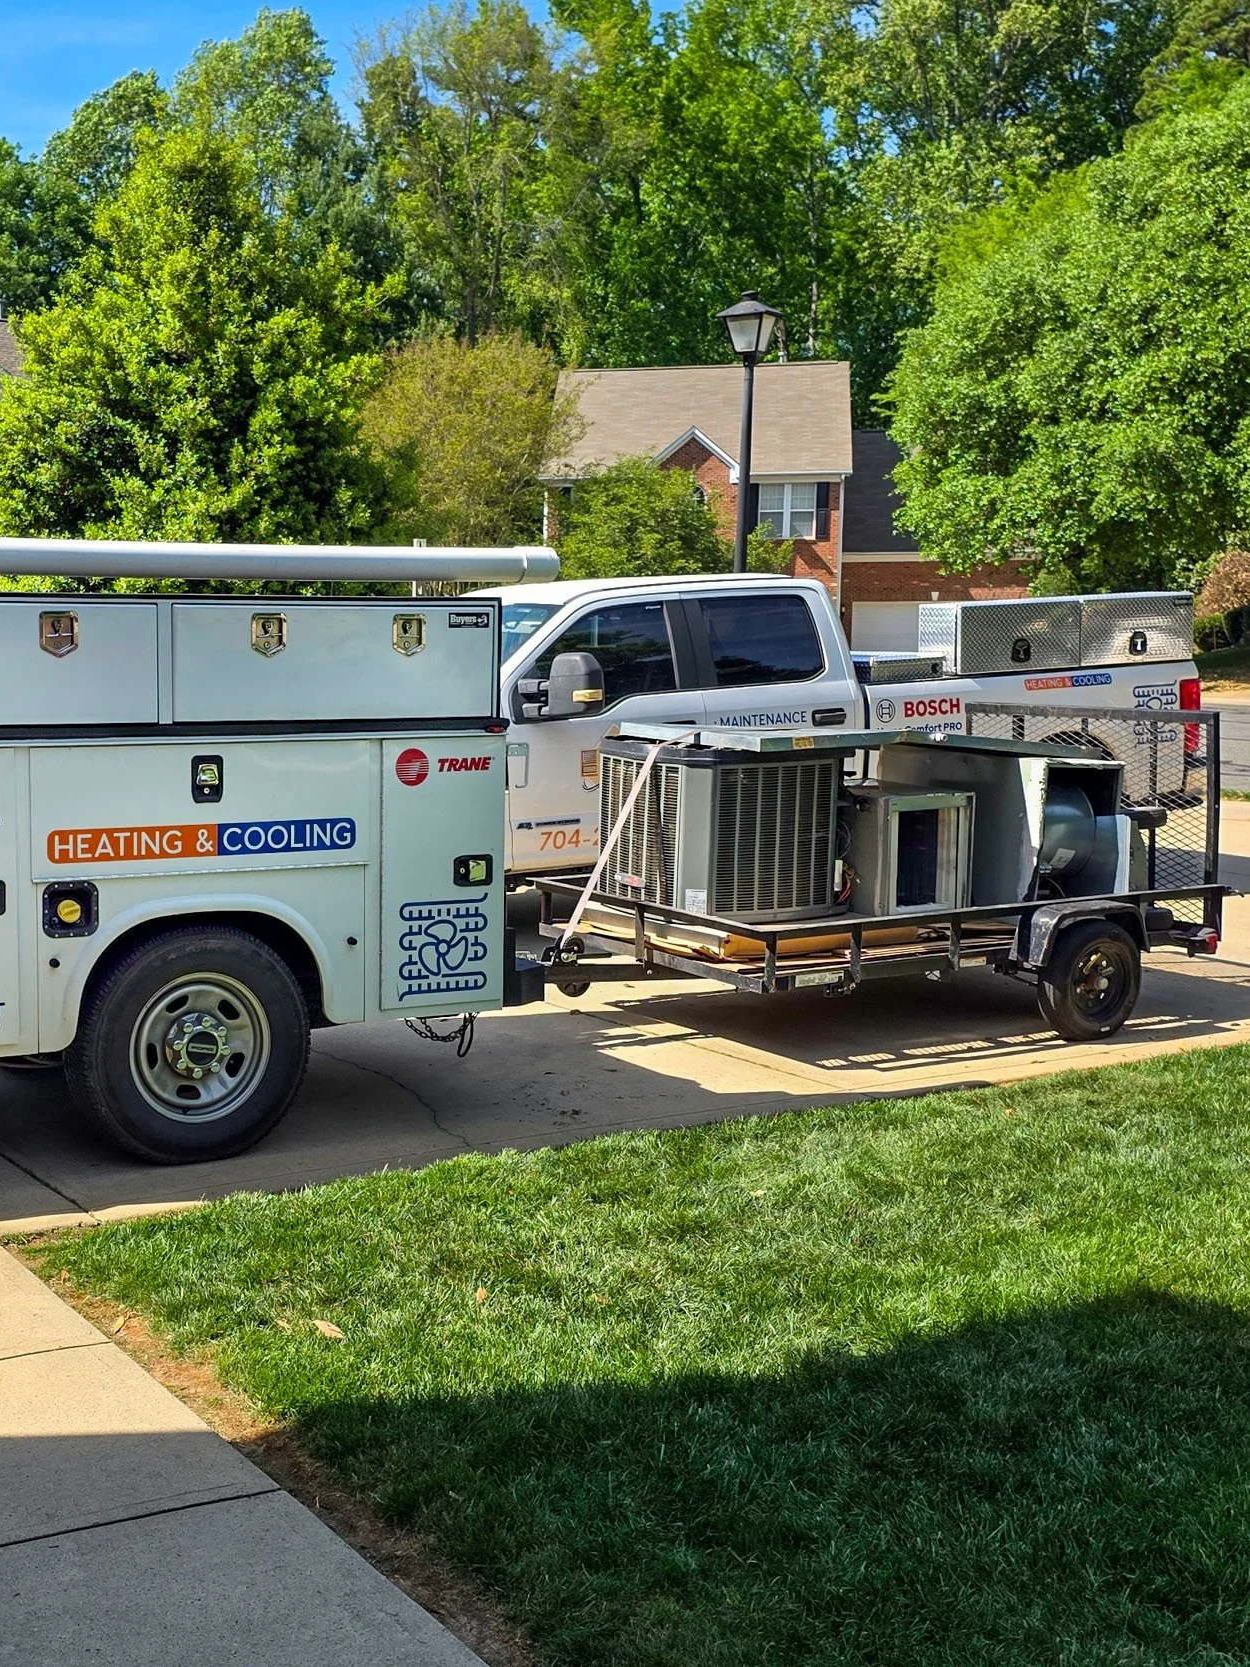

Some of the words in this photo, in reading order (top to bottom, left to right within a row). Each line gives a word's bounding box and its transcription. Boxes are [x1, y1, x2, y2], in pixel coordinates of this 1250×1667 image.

[450, 614, 477, 624] Buyers
[1025, 678, 1062, 689] HEATING
[1065, 677, 1071, 687] &
[1072, 674, 1111, 686] COOLING
[904, 697, 961, 718] BOSCH
[720, 711, 808, 727] MAINTENANCE
[943, 722, 963, 731] PRO
[437, 756, 492, 772] TRANE
[53, 829, 183, 860] HEATING
[195, 828, 214, 853] &
[222, 822, 351, 851] COOLING
